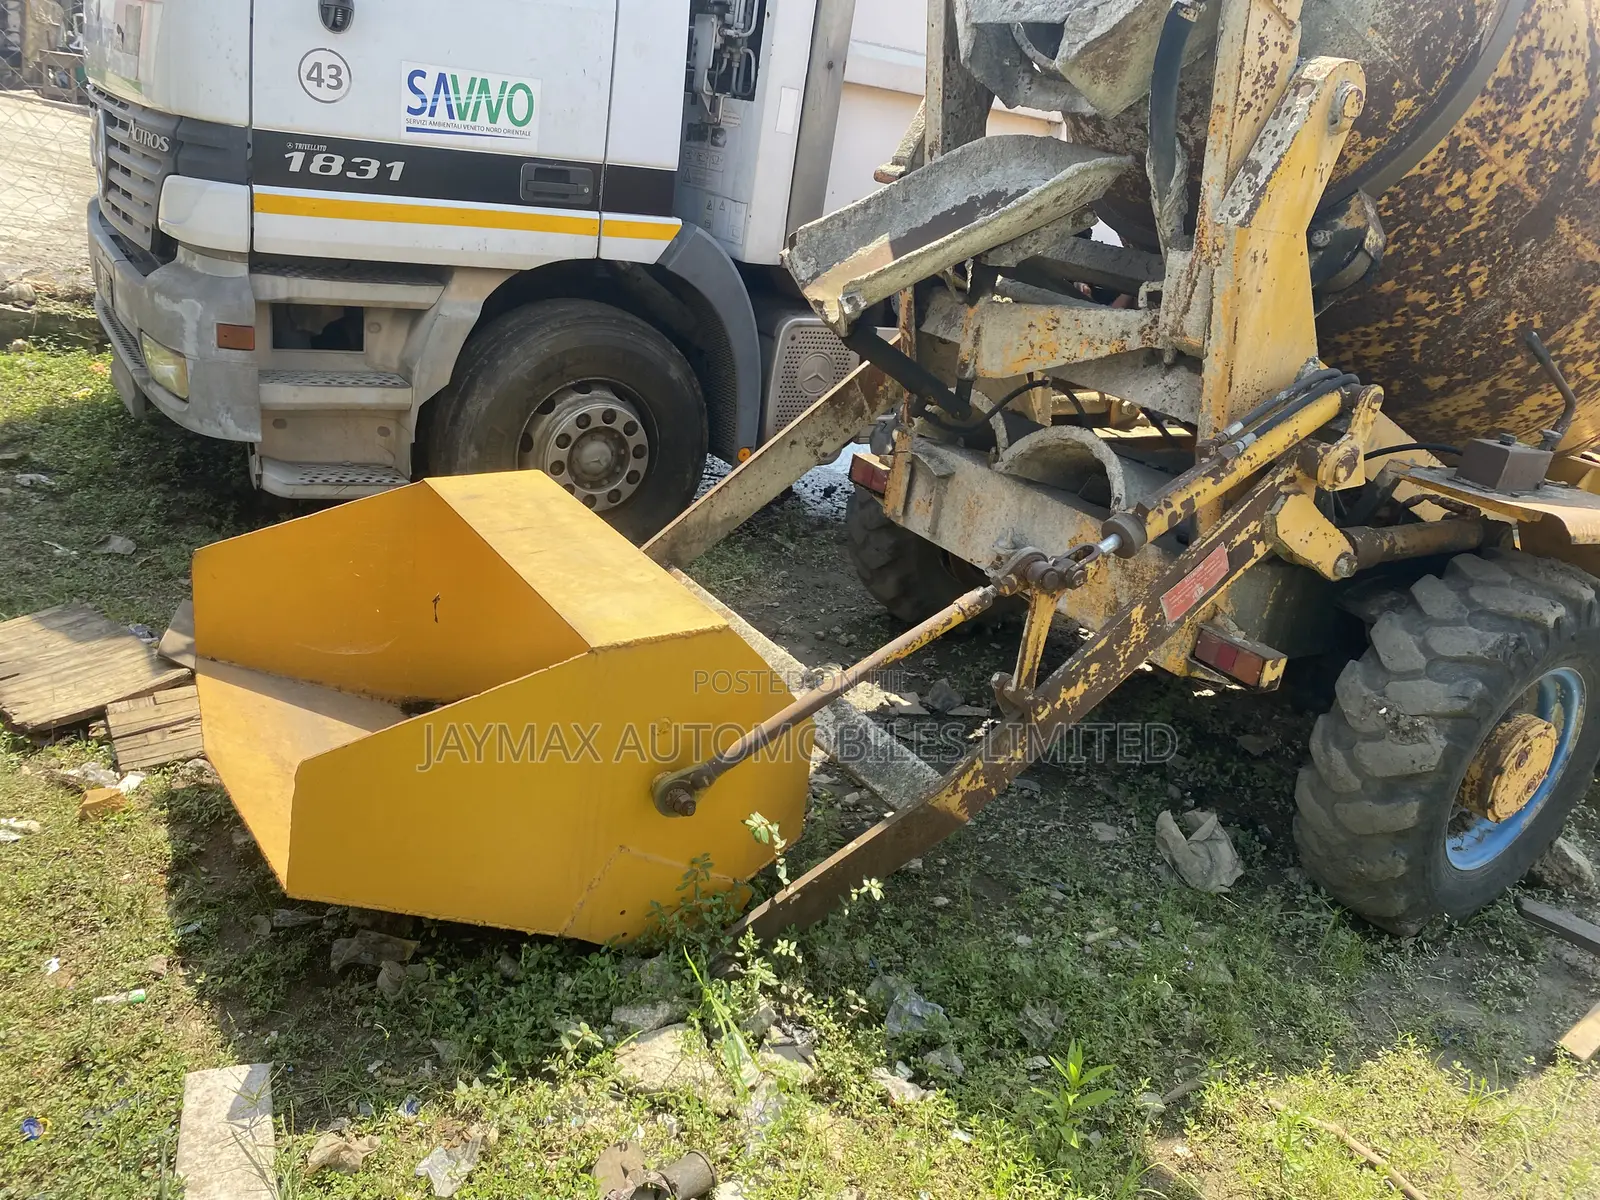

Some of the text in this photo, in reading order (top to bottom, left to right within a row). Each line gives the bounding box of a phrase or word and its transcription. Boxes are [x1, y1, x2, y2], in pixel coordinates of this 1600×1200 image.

[306, 61, 343, 91] 43
[406, 69, 535, 127] SAVNO
[405, 118, 532, 137] SERVIZI AMBIENTALI VENETO NORD ORIENTALE
[294, 142, 328, 152] TRIVELLATO
[284, 151, 406, 181] 1831
